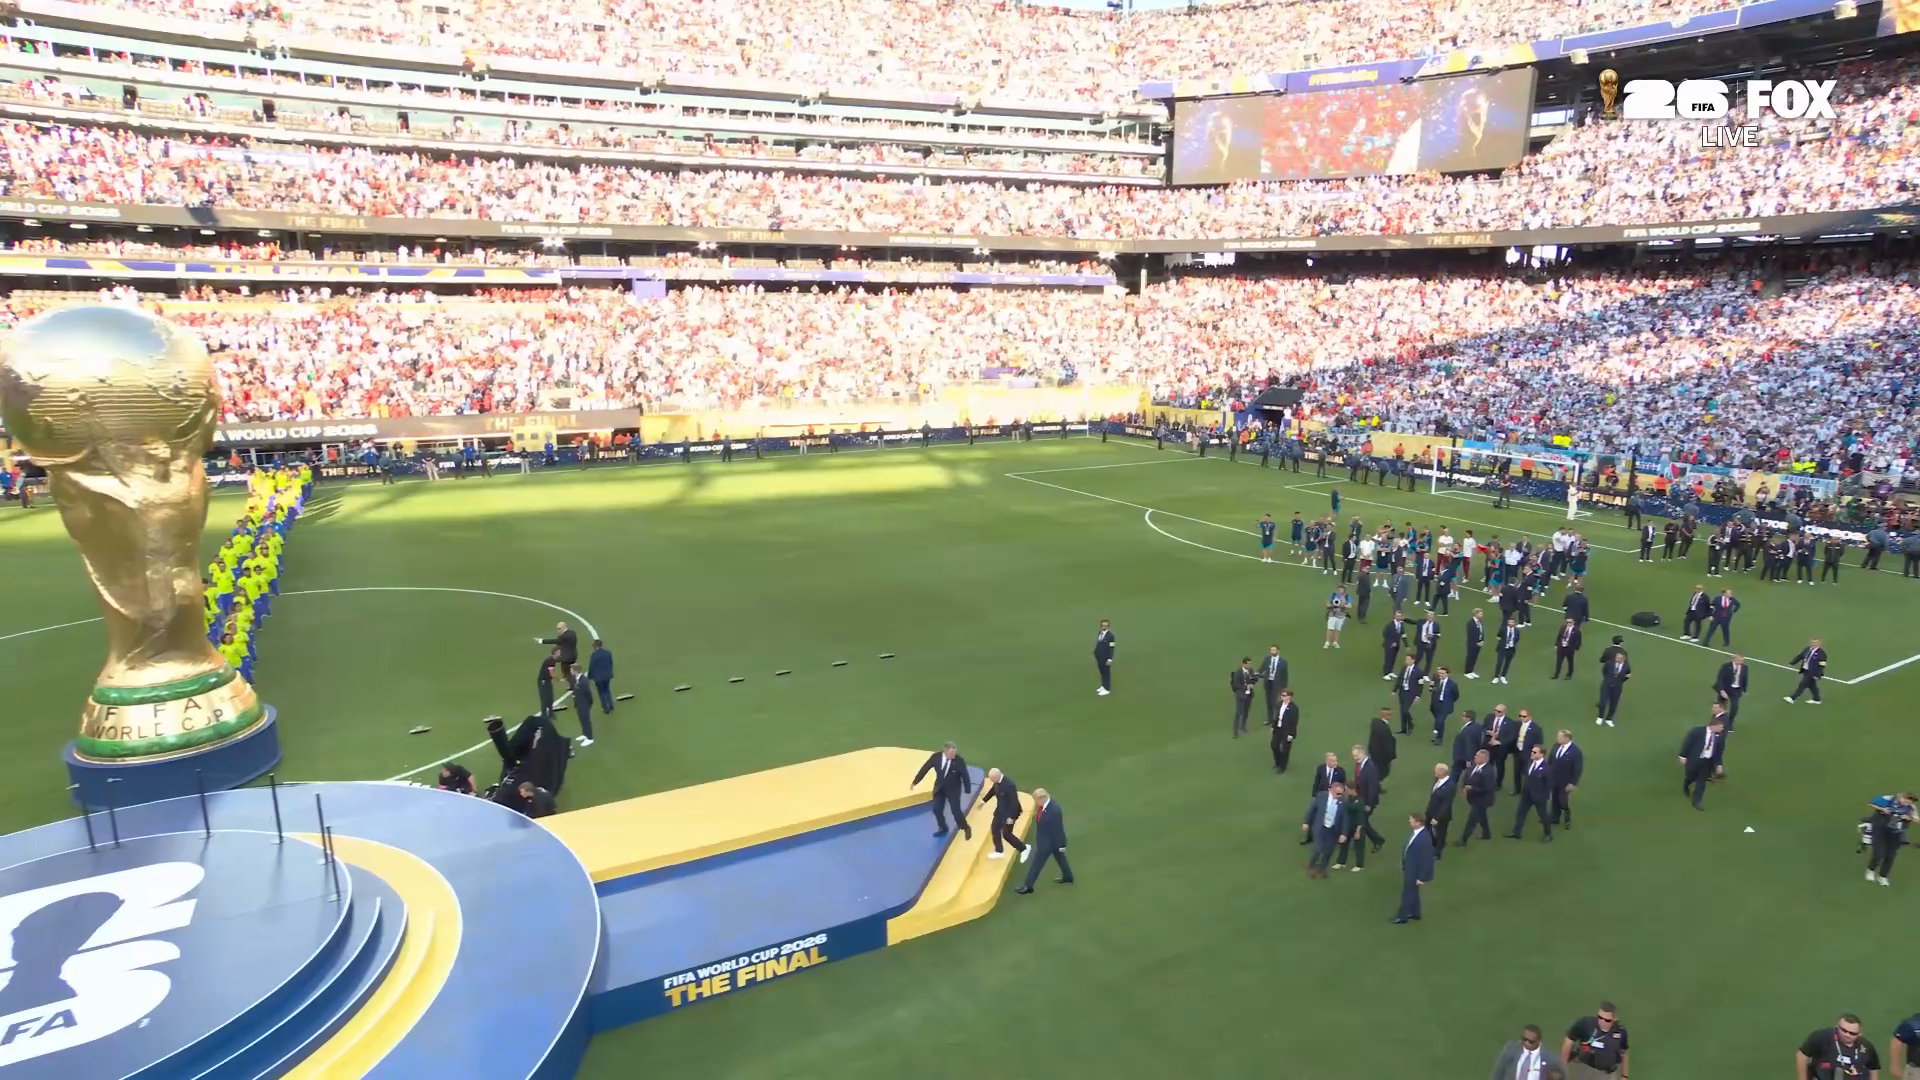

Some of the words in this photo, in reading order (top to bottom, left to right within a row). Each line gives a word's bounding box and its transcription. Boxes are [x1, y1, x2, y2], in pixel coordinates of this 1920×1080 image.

[227, 426, 287, 441] WORLD
[289, 425, 322, 438] CUP
[663, 971, 697, 989] FIFA
[697, 956, 750, 980] WORLD
[750, 947, 779, 964] CUP
[780, 933, 828, 955] 2026
[664, 972, 732, 1007] THE
[736, 946, 828, 988] FINAL
